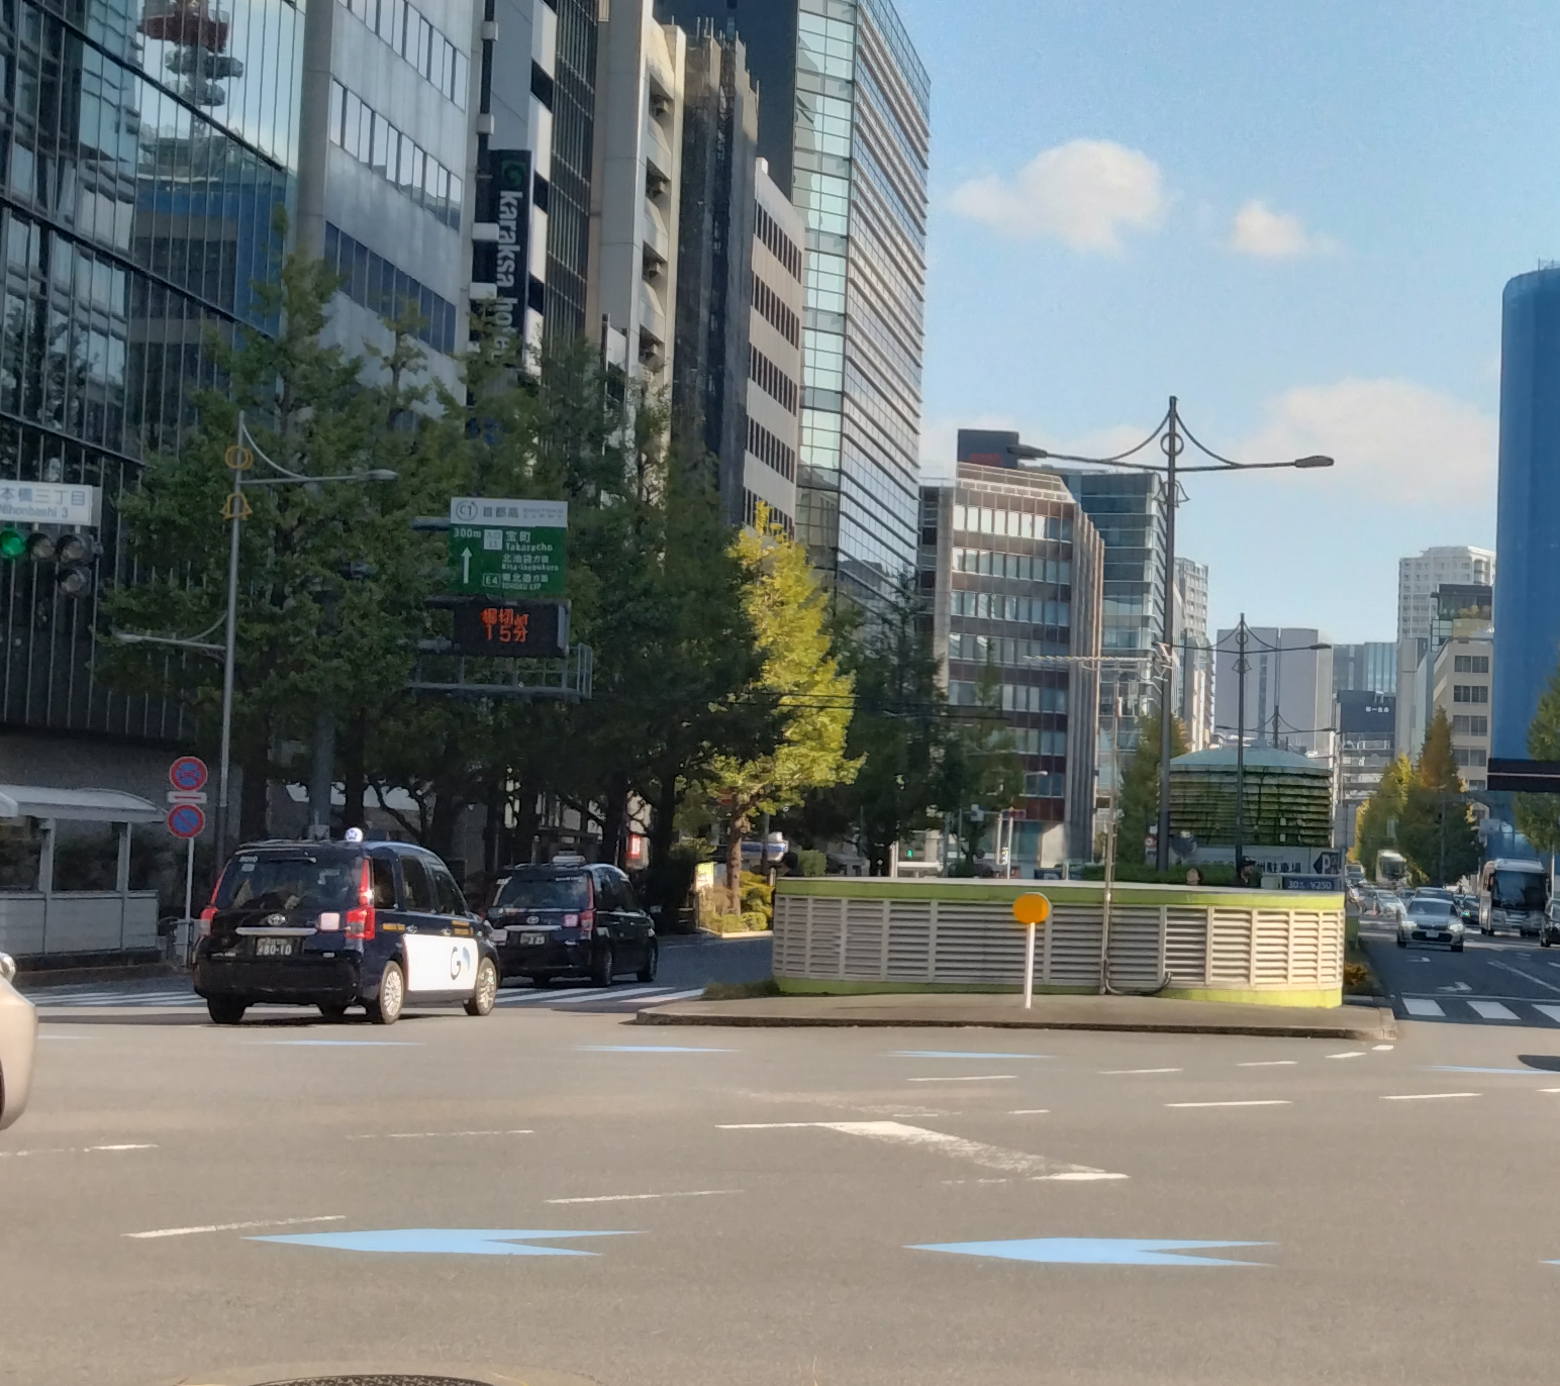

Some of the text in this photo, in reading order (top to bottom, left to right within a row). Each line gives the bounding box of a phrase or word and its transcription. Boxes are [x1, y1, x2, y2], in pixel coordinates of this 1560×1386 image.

[496, 191, 523, 288] karaksa
[61, 507, 69, 518] 3
[453, 527, 482, 538] 300m
[505, 530, 532, 542] 宝町
[484, 625, 528, 642] 15分
